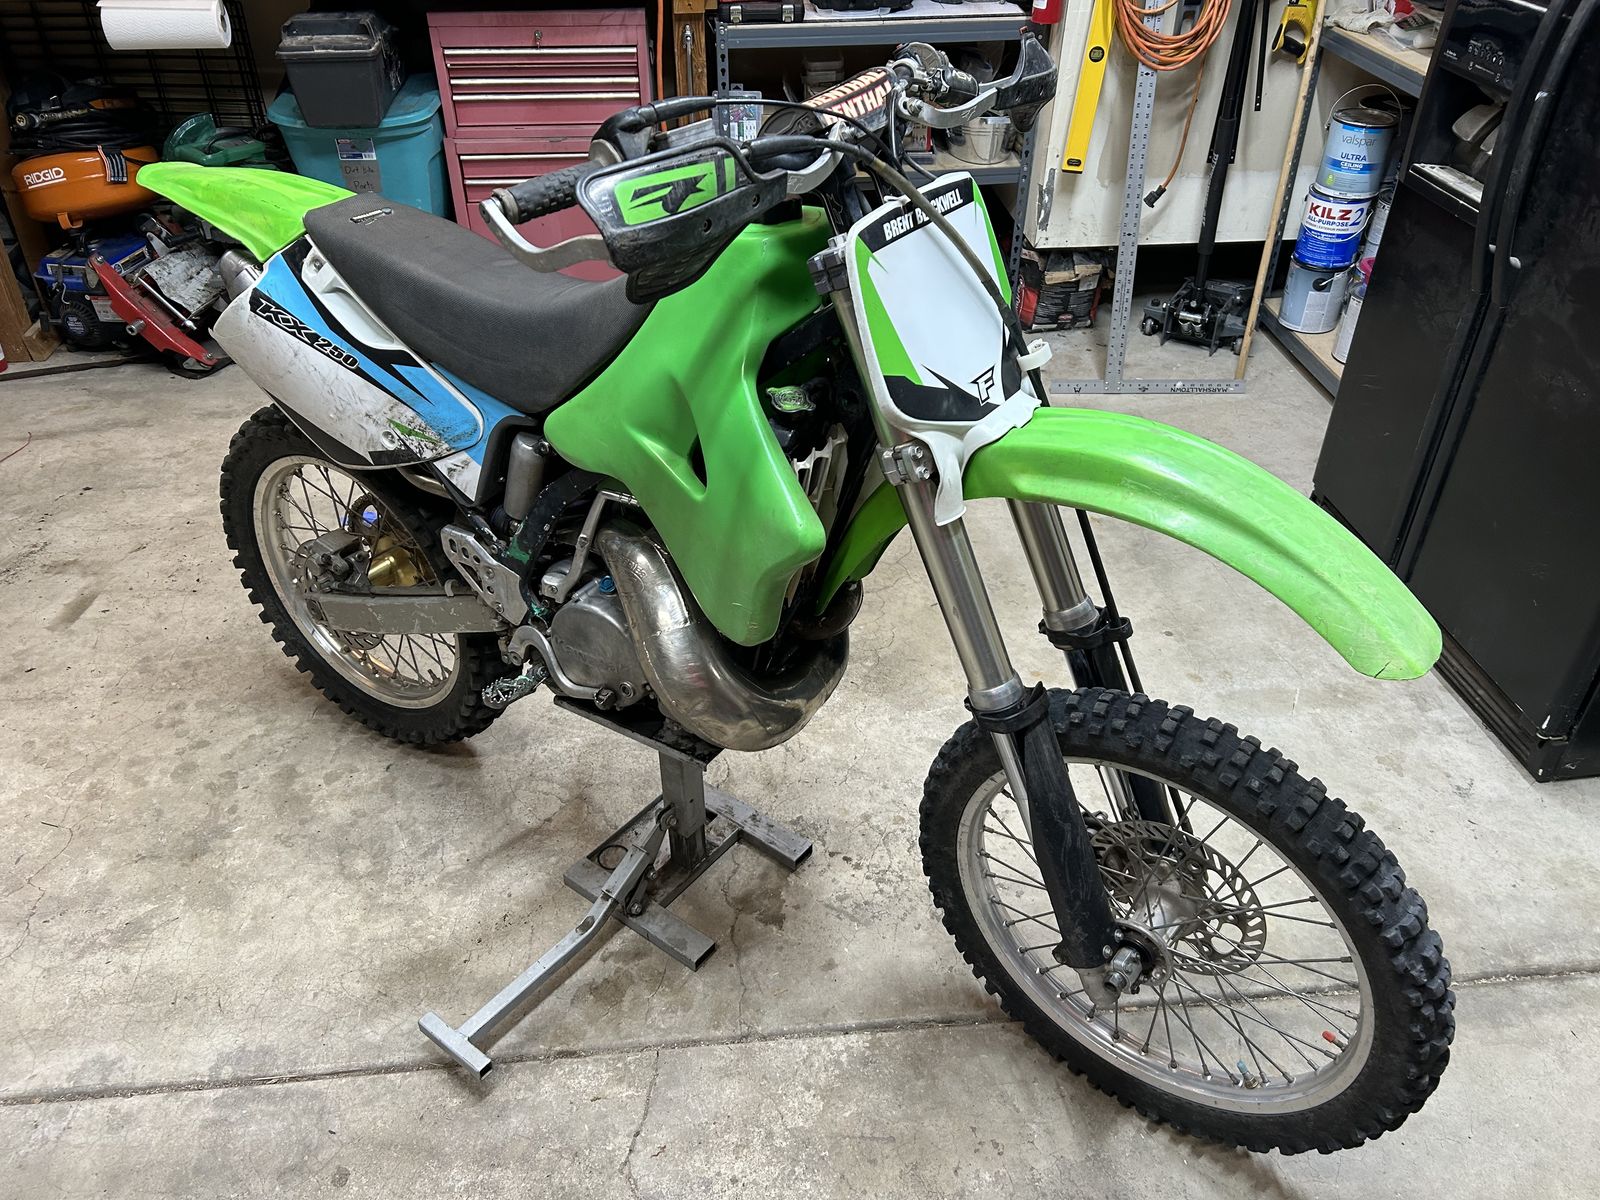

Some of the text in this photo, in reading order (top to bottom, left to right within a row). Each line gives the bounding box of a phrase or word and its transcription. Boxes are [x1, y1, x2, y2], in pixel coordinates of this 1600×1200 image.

[1342, 134, 1376, 147] valspar
[1340, 152, 1367, 162] ULTRA
[23, 167, 65, 185] RIDGID
[1308, 214, 1350, 227] ALL-PURPOSE
[1309, 203, 1353, 220] KILZ
[1349, 207, 1365, 227] 2
[882, 211, 915, 241] BRENT
[256, 298, 360, 369] KX 250
